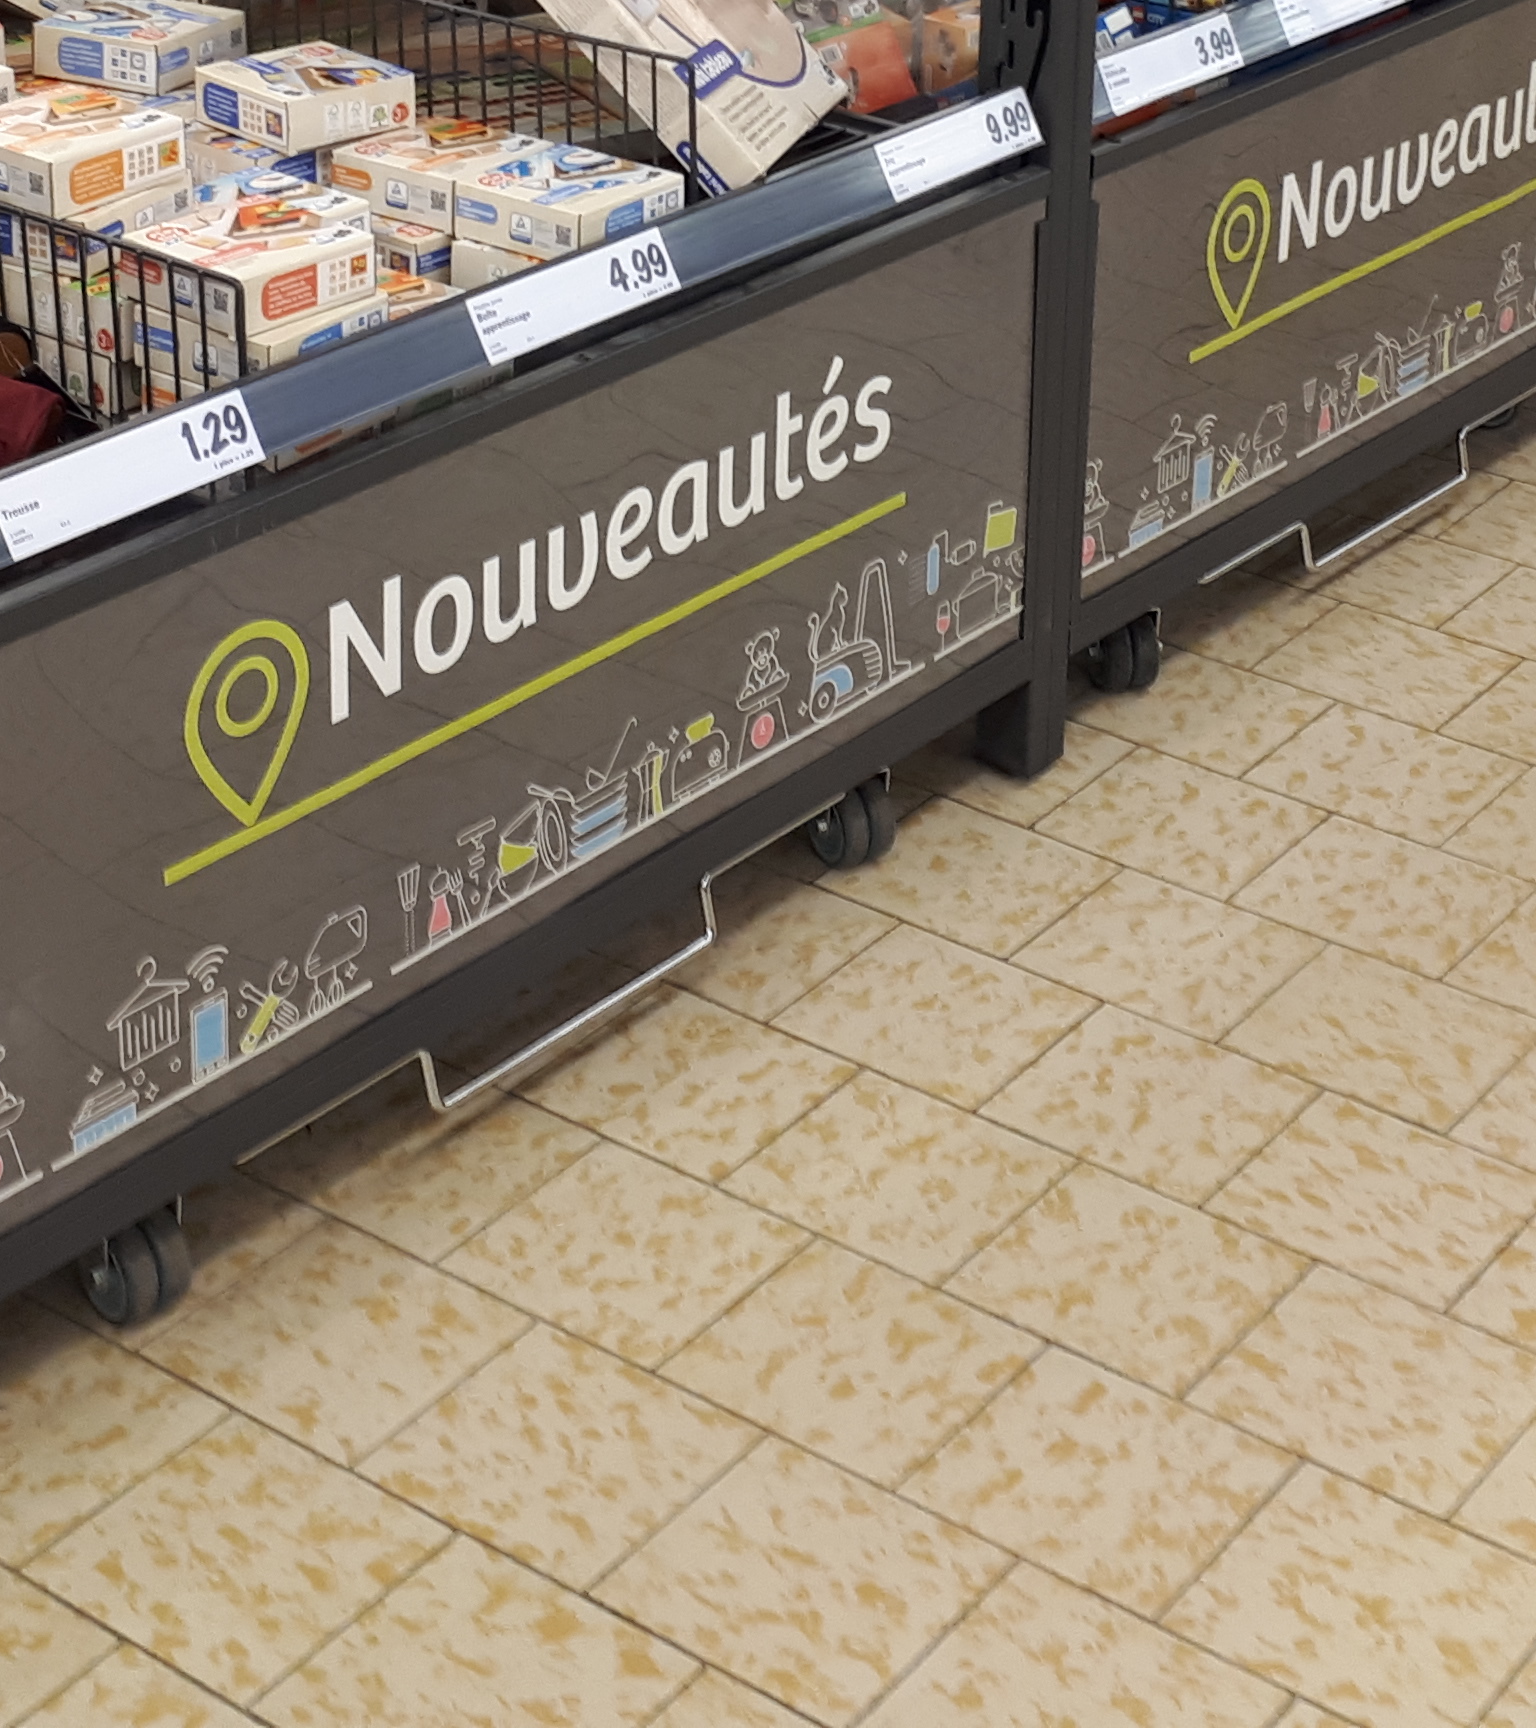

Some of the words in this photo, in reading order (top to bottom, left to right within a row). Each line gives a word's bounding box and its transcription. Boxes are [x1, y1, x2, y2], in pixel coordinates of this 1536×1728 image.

[1194, 26, 1236, 67] 3.99
[985, 101, 1032, 145] 9.99
[610, 242, 669, 292] 4.99
[181, 404, 249, 462] 1.29
[1, 499, 41, 521] Trousse
[328, 354, 894, 726] Nouveautés
